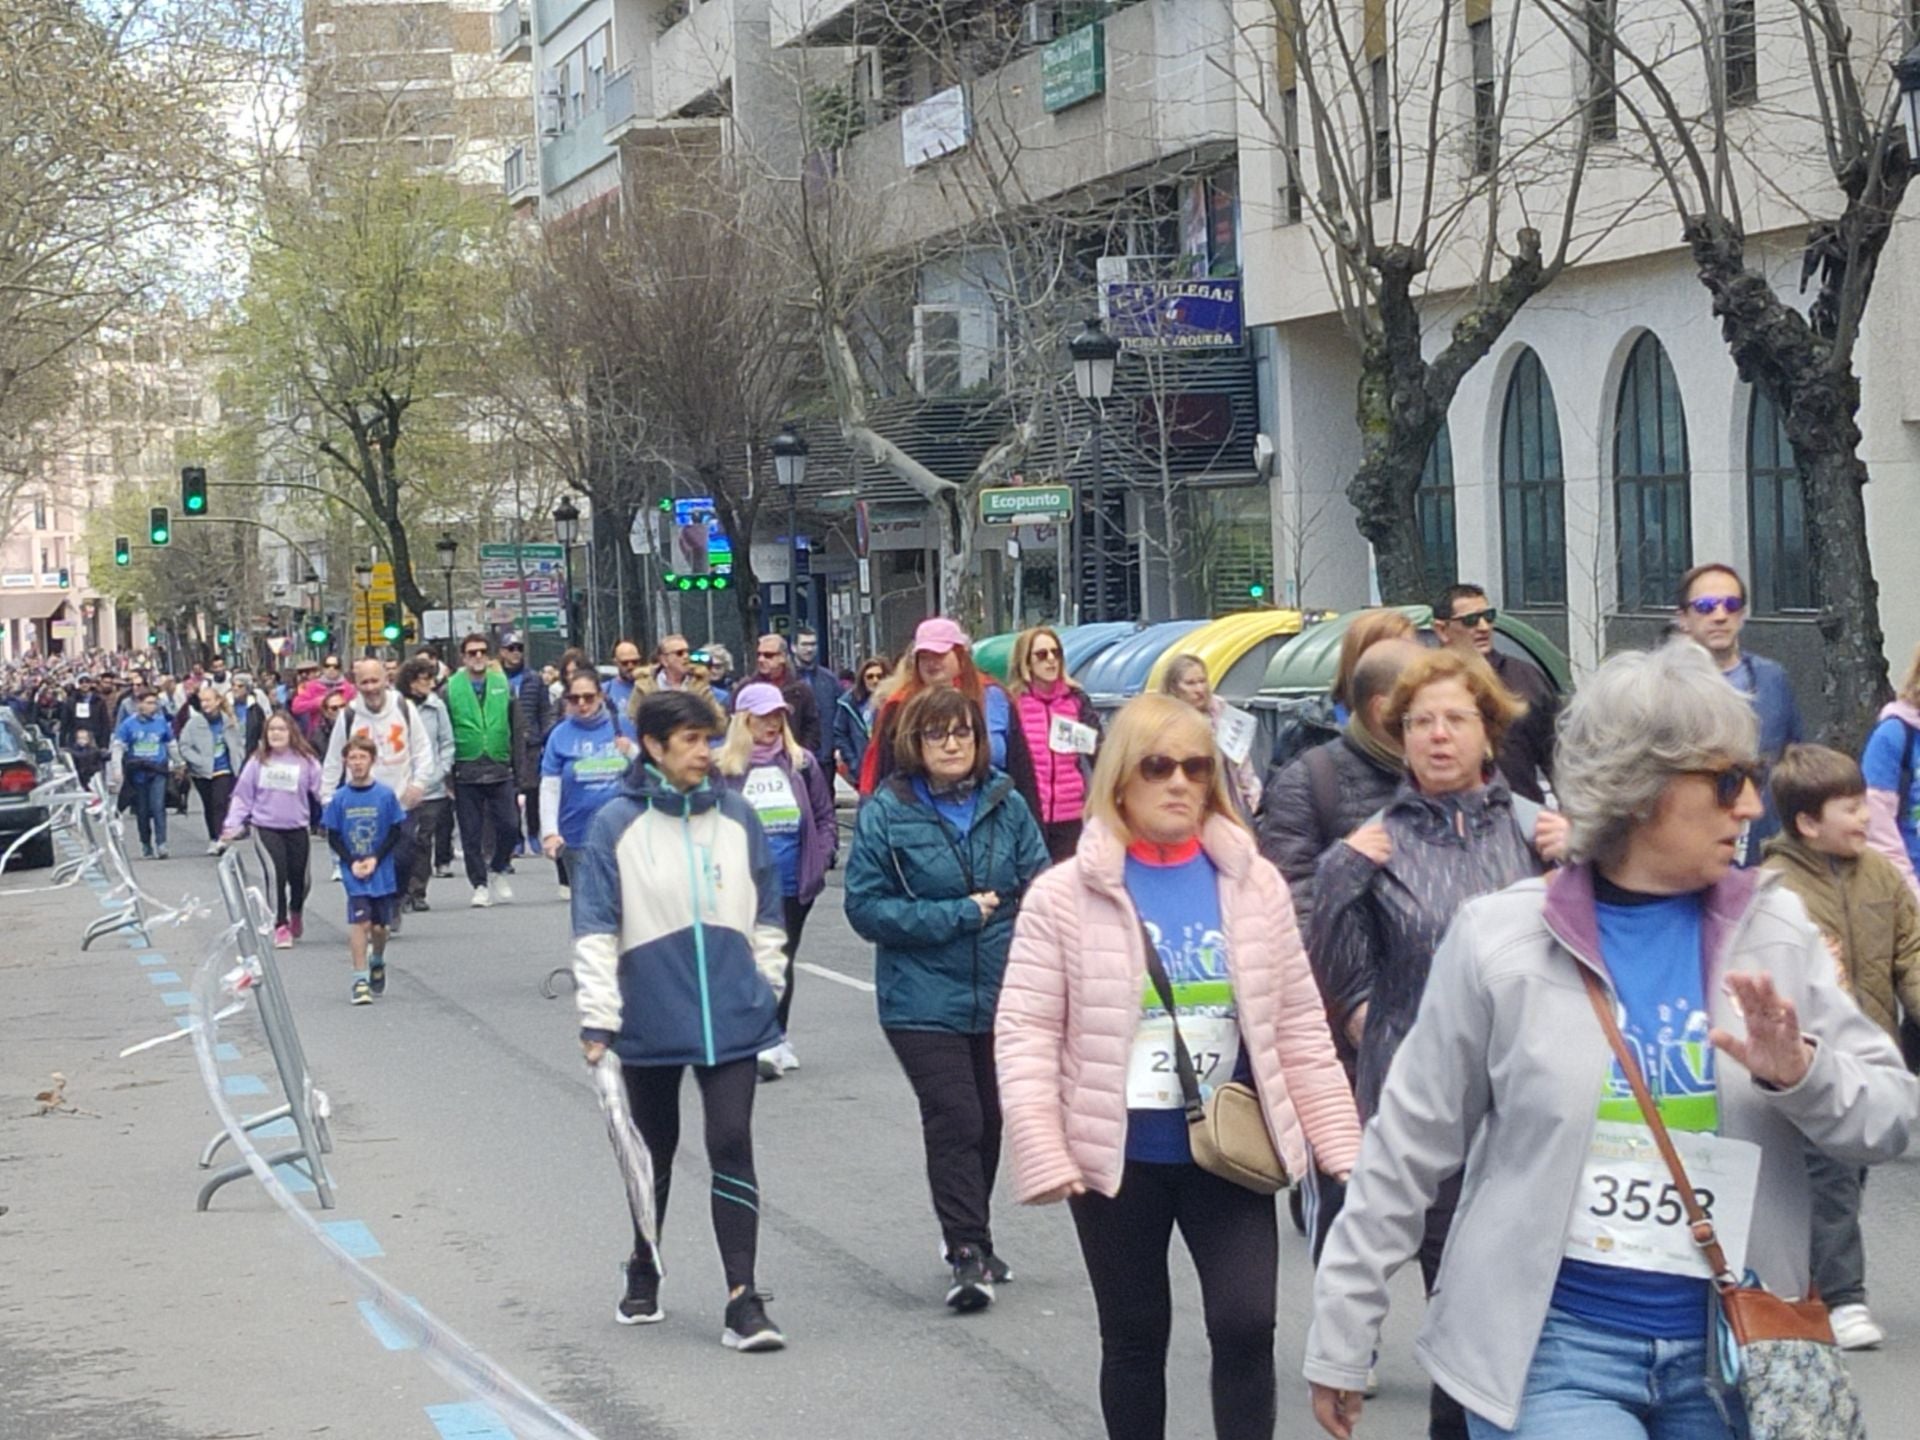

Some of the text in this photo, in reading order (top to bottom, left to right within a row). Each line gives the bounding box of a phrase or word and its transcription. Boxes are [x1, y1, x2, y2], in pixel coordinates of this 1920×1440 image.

[1153, 282, 1234, 303] VILEGAS
[991, 493, 1060, 510] Ecopunto
[1152, 1051, 1220, 1080] 217
